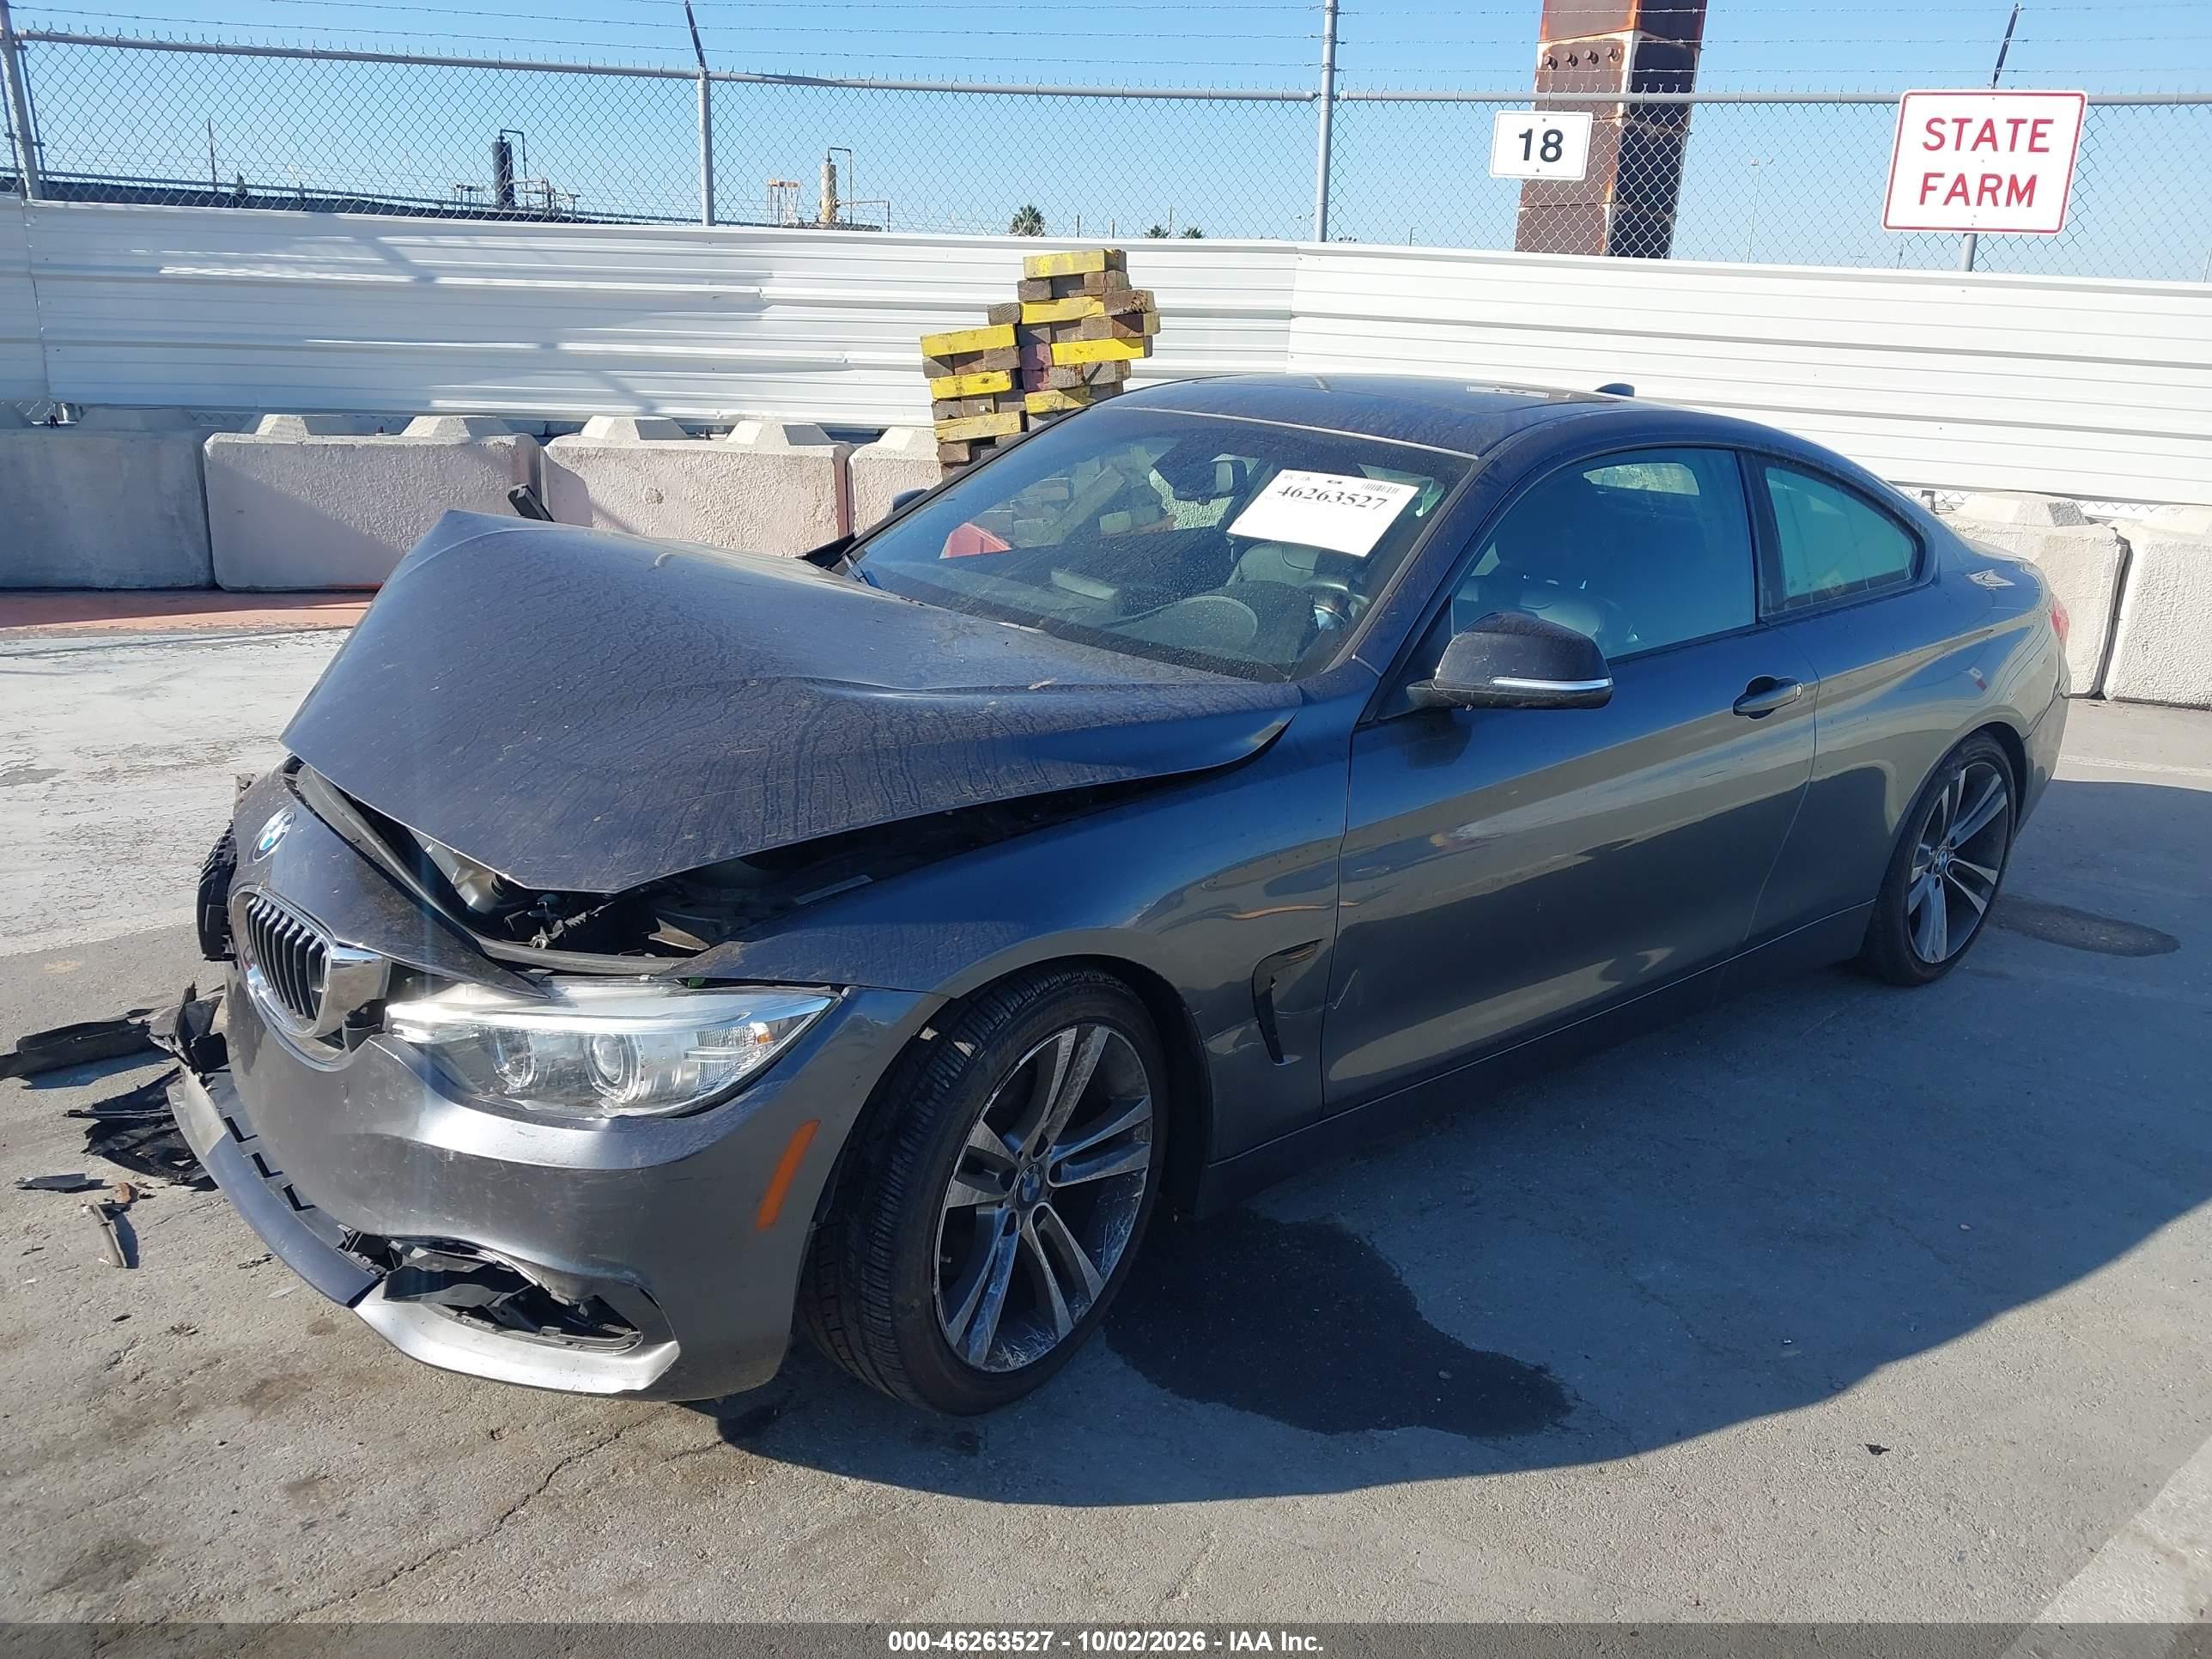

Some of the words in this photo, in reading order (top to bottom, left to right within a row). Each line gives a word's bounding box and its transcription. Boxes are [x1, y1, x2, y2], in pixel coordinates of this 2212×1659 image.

[1518, 128, 1564, 163] 18
[1922, 117, 2054, 153] STATE
[1918, 172, 2038, 208] FARM
[1278, 485, 1388, 510] 46263527
